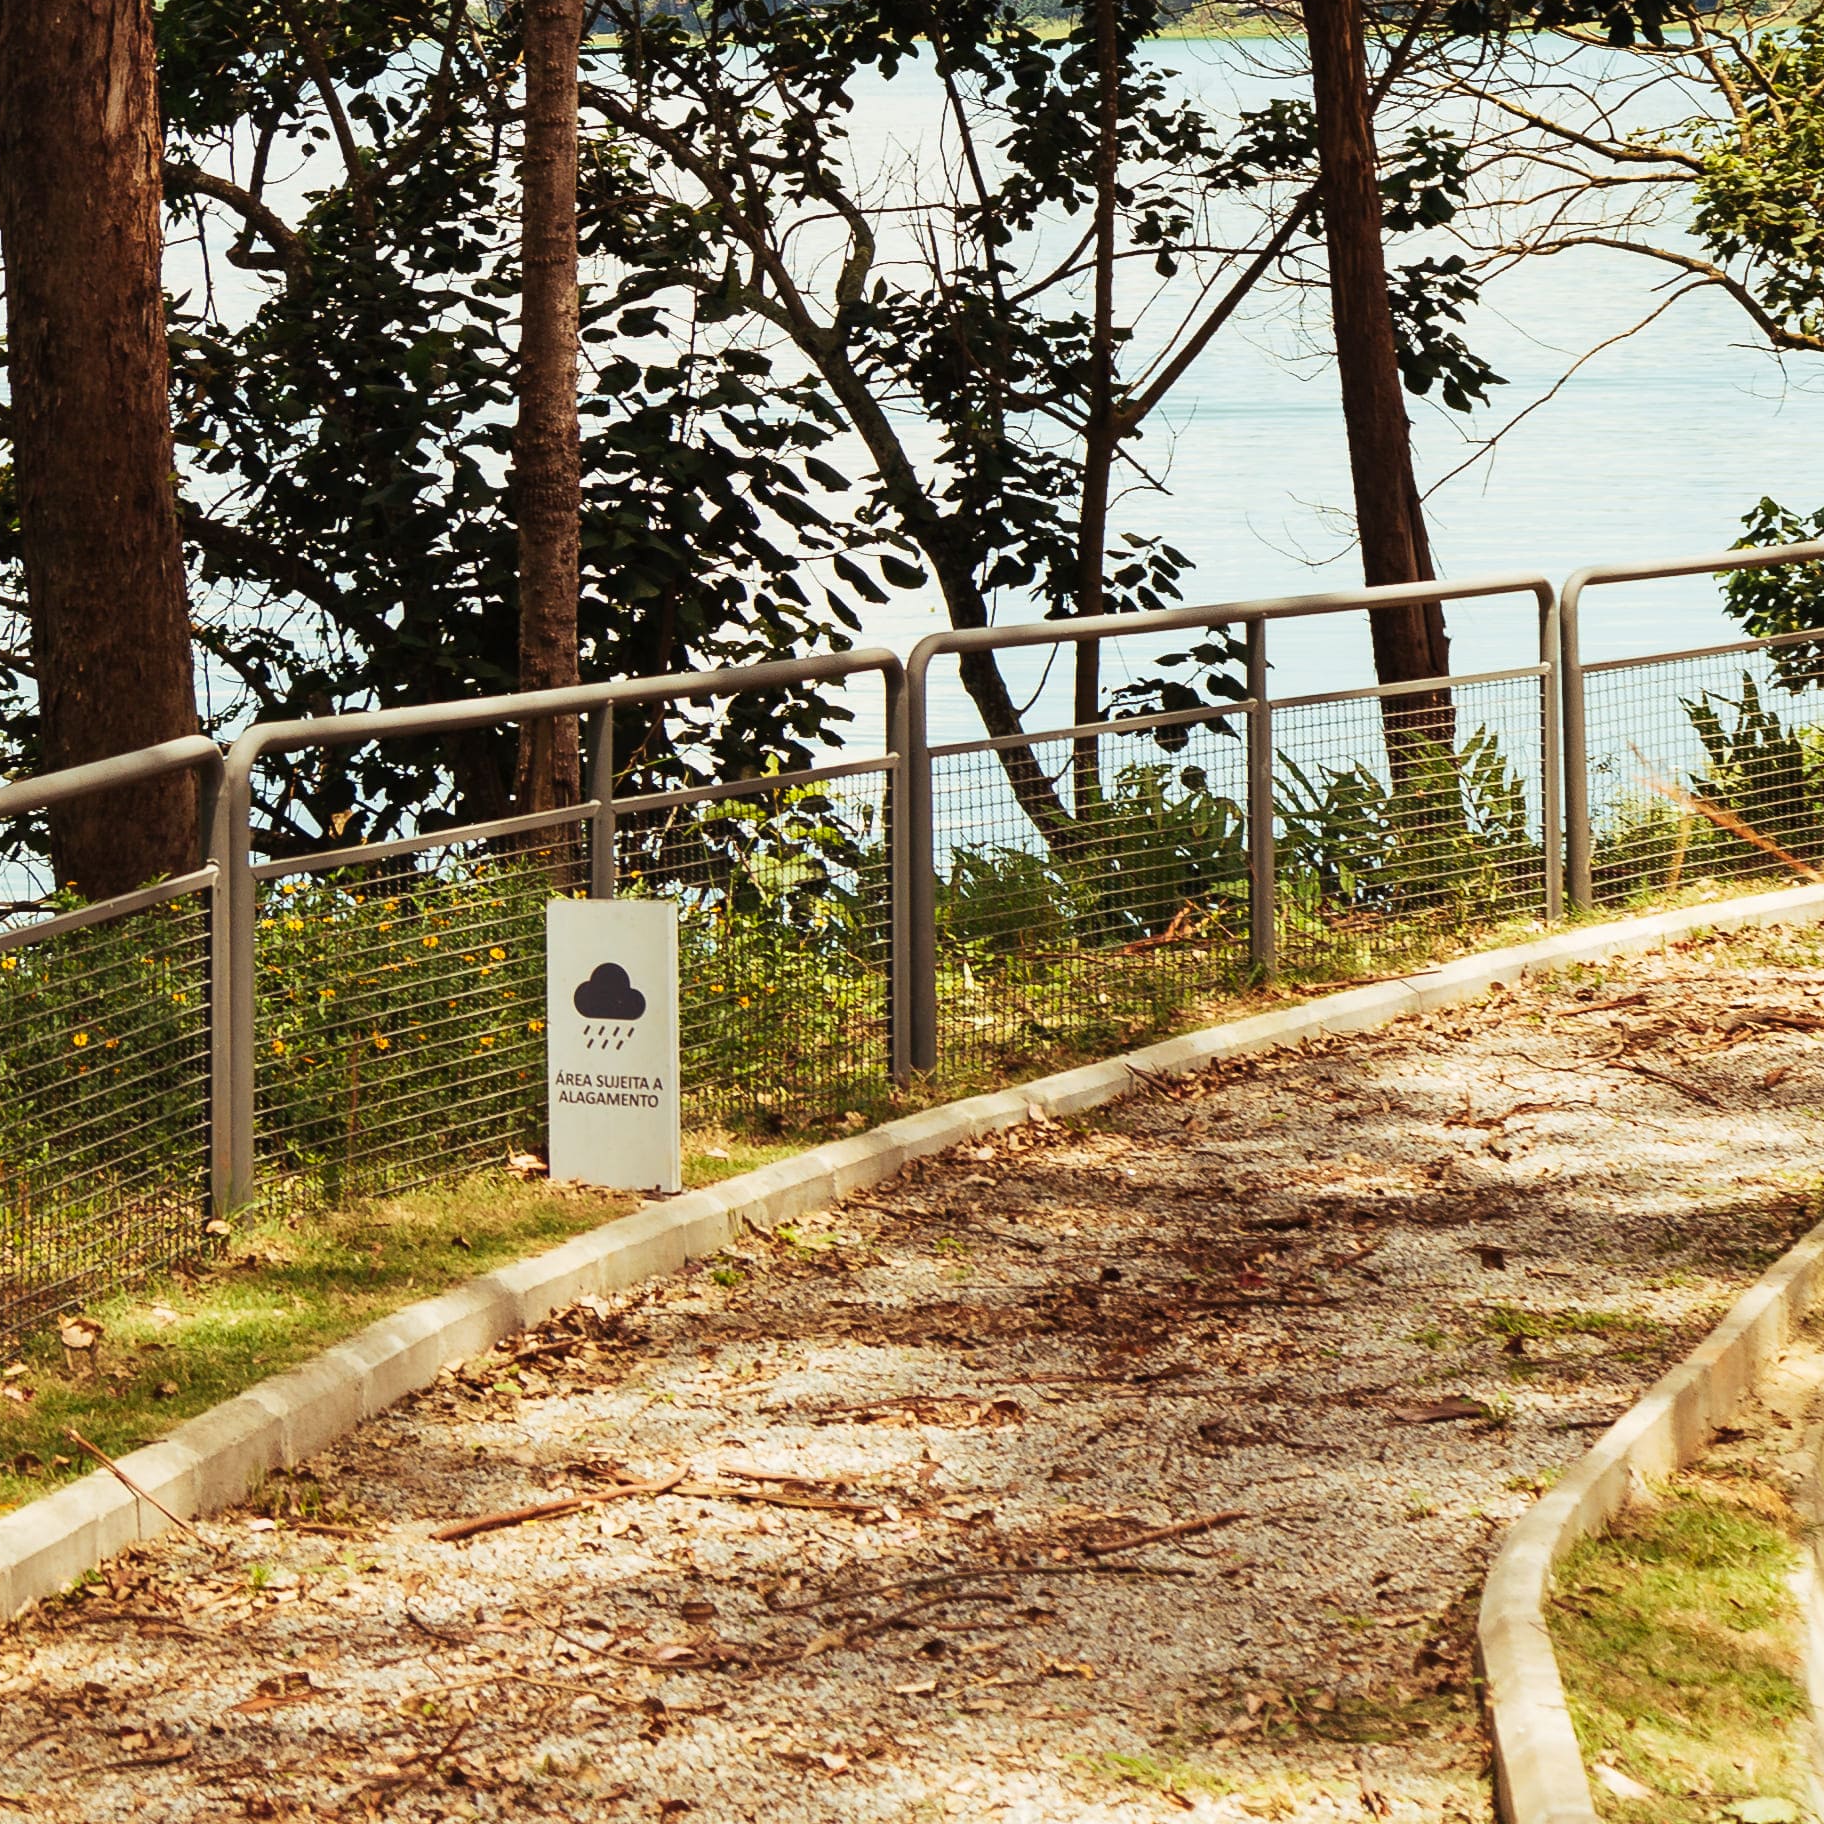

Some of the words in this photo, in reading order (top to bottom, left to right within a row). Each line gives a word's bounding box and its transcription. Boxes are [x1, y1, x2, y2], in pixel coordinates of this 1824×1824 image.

[555, 1069, 592, 1087] ÁREA
[596, 1074, 650, 1090] SUJEITA
[652, 1077, 663, 1091] A
[559, 1091, 659, 1108] ALAGAMENTO
